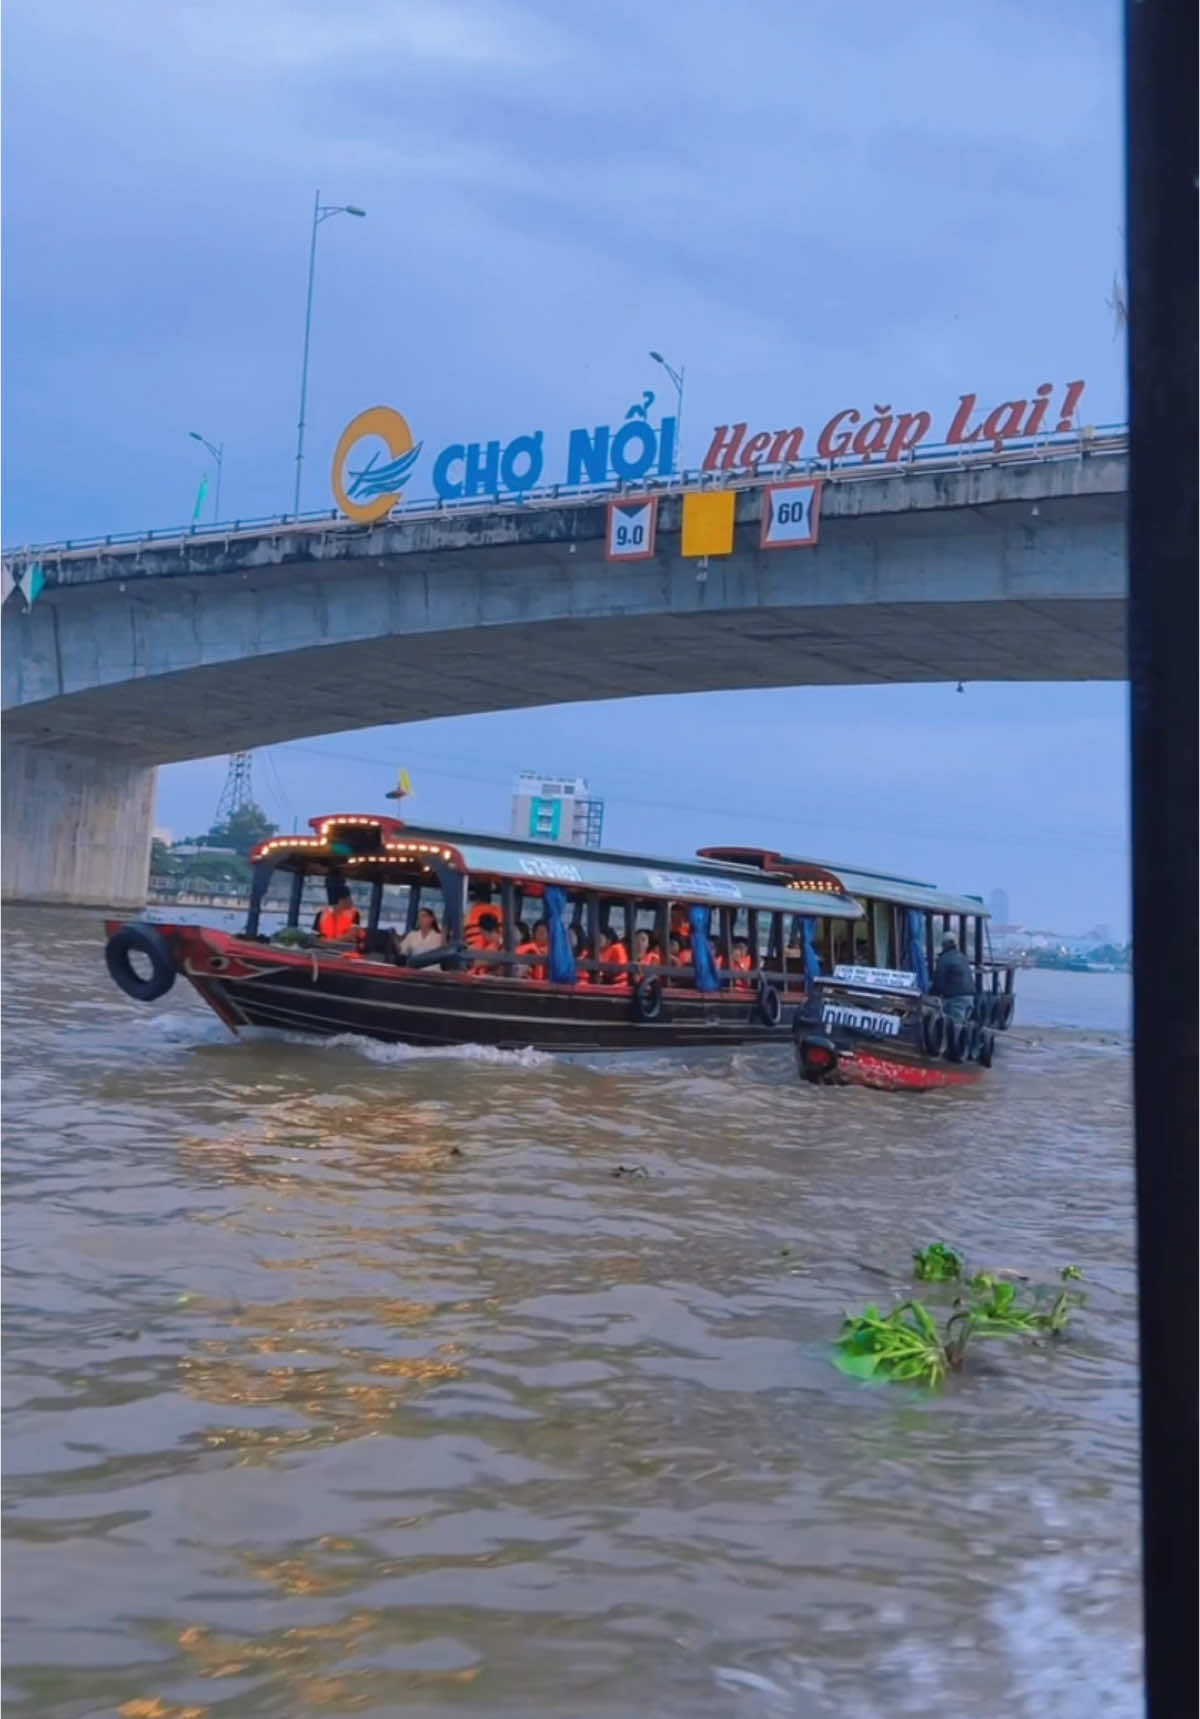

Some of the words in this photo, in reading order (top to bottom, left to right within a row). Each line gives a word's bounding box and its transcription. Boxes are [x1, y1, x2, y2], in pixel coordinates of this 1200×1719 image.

[432, 430, 543, 505] CHỢ
[568, 391, 677, 484] NỔI
[818, 404, 931, 462] Gặp
[777, 502, 803, 524] 60
[616, 525, 643, 545] 9.0
